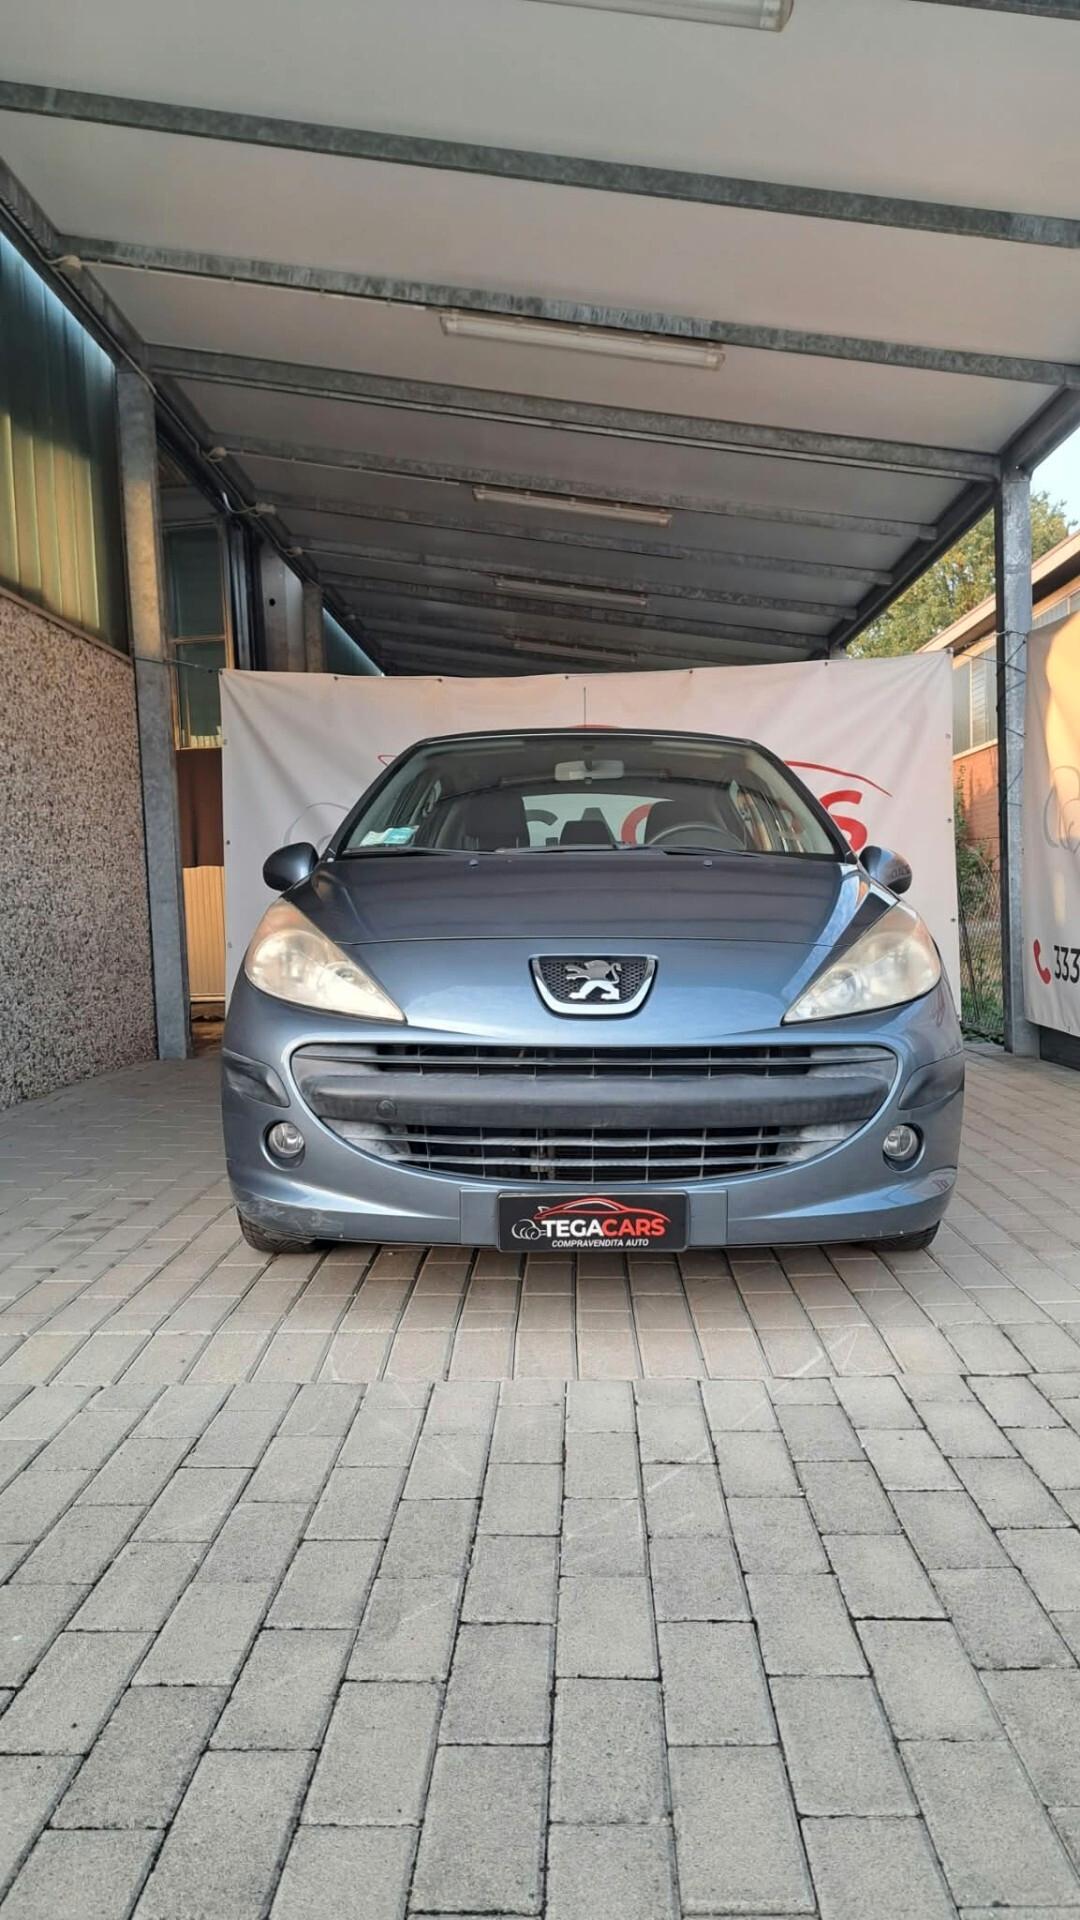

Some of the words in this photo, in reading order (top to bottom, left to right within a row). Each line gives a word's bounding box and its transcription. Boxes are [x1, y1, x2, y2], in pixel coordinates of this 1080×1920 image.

[541, 1218, 665, 1238] TEGACARS
[551, 1239, 624, 1248] COMPRAVENDITA
[625, 1238, 649, 1247] AUTO
